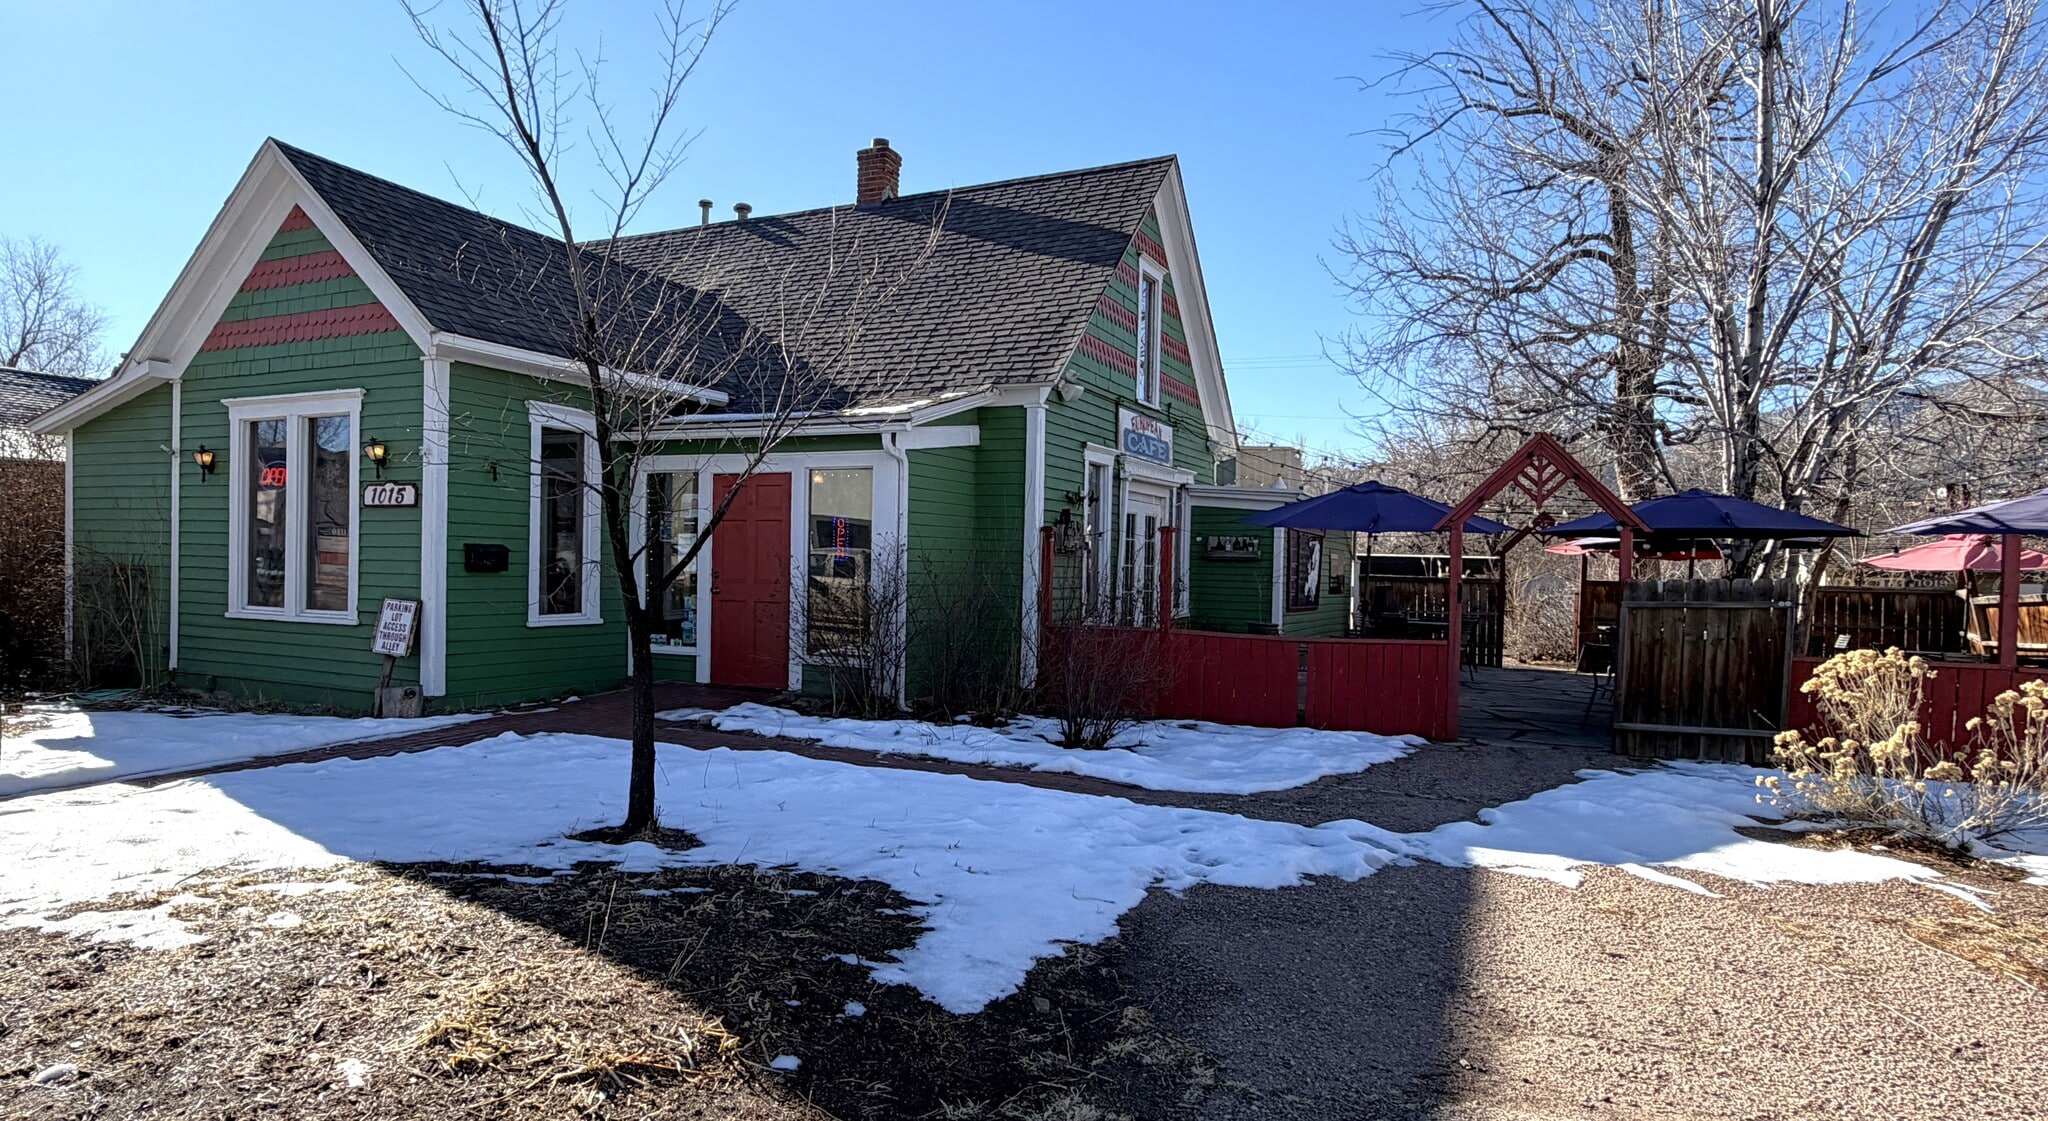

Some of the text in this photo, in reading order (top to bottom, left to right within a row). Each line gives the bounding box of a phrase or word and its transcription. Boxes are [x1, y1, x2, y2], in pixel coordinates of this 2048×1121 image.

[371, 487, 407, 504] 1015
[836, 518, 846, 559] OPEN
[386, 602, 413, 613] PARKING
[391, 612, 403, 622] LOT
[382, 621, 408, 633] ACCESS
[379, 631, 407, 643] THROUGH
[381, 641, 400, 652] ALLEY
